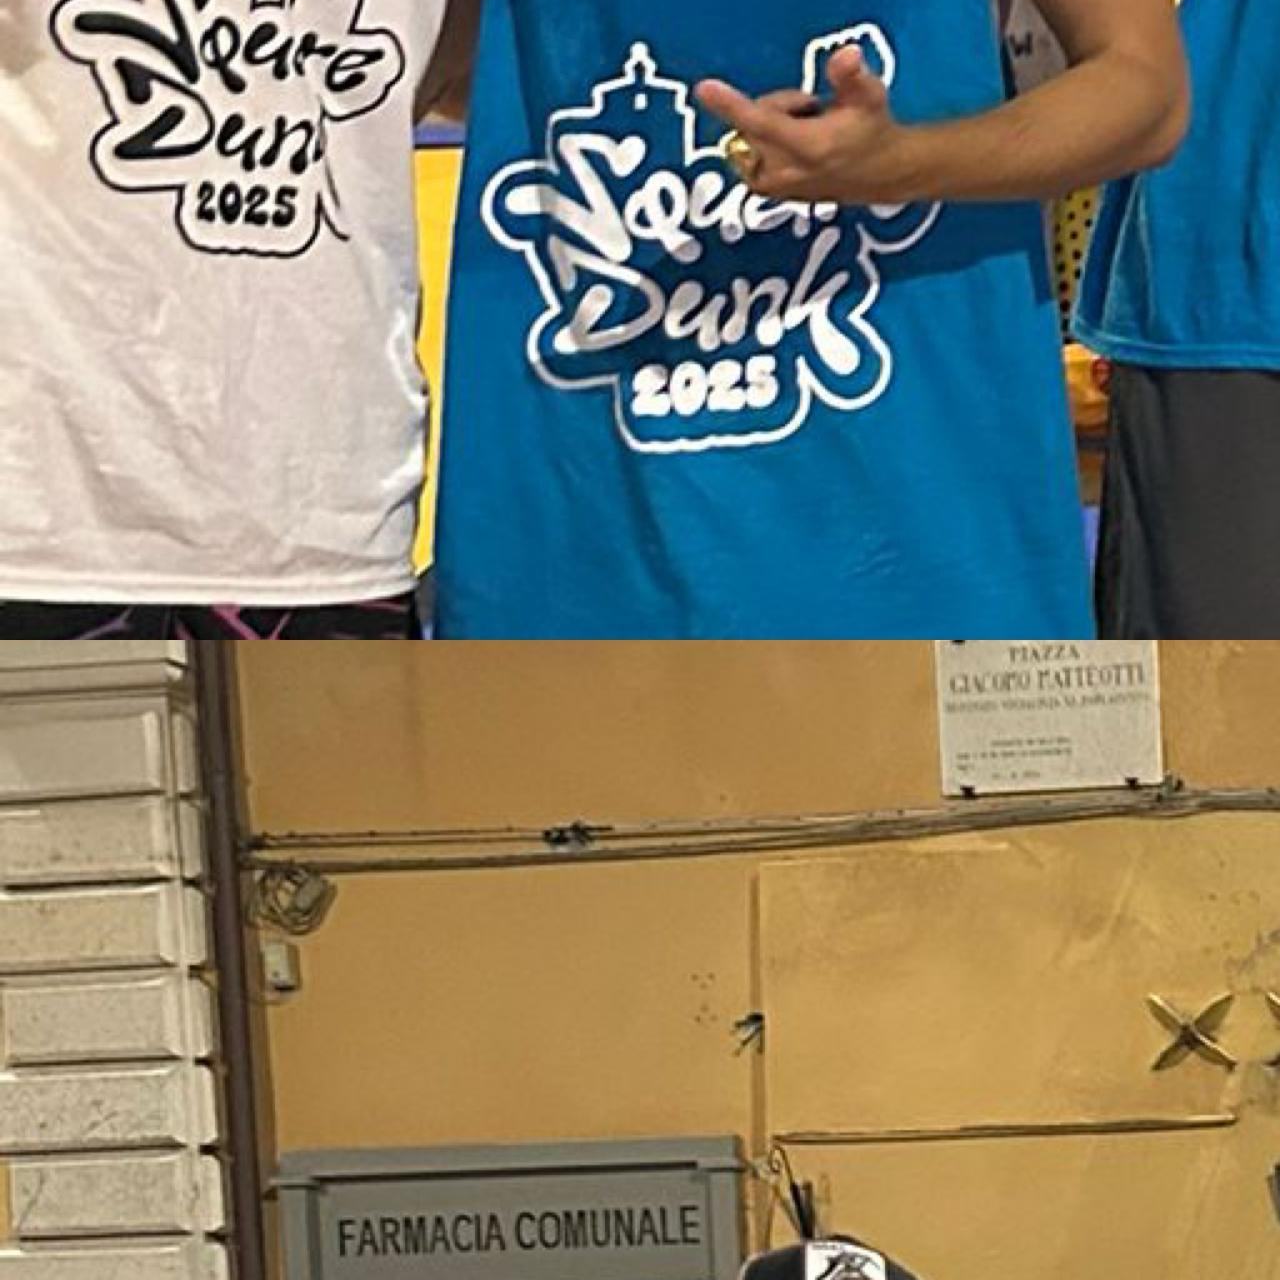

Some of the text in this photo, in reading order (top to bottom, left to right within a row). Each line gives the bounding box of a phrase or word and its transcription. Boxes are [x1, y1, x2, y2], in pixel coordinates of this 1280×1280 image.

[113, 57, 325, 174] Dun
[195, 181, 298, 226] 2025
[547, 227, 861, 375] Dunk
[631, 355, 779, 417] 2025
[338, 1205, 702, 1258] FARMACIA COMUNALE
